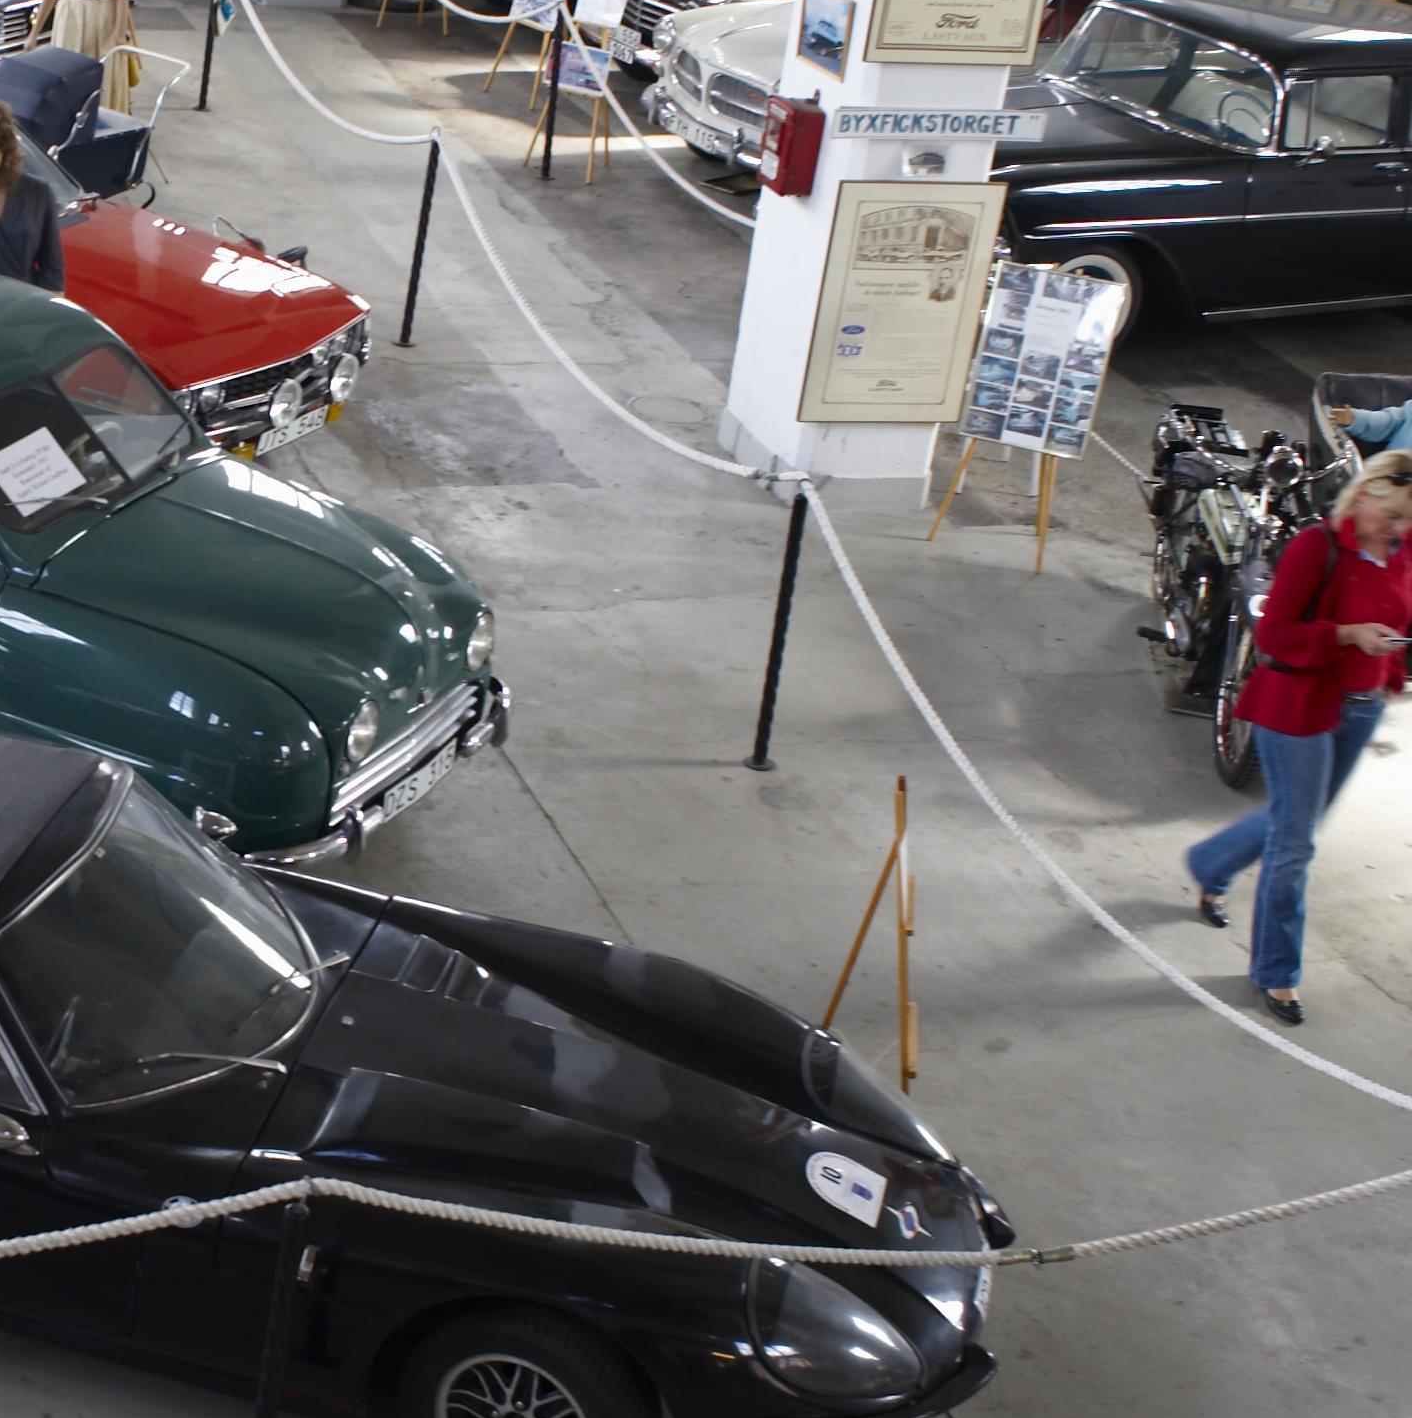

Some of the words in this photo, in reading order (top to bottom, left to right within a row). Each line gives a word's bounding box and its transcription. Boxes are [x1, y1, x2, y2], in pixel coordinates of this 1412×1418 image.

[935, 12, 981, 30] Ford
[838, 112, 1022, 136] BYXFICKSTORGET
[258, 425, 290, 452] JTS
[297, 407, 326, 435] 548
[385, 777, 418, 817] DZS
[428, 745, 454, 786] 315
[819, 1165, 843, 1186] 10
